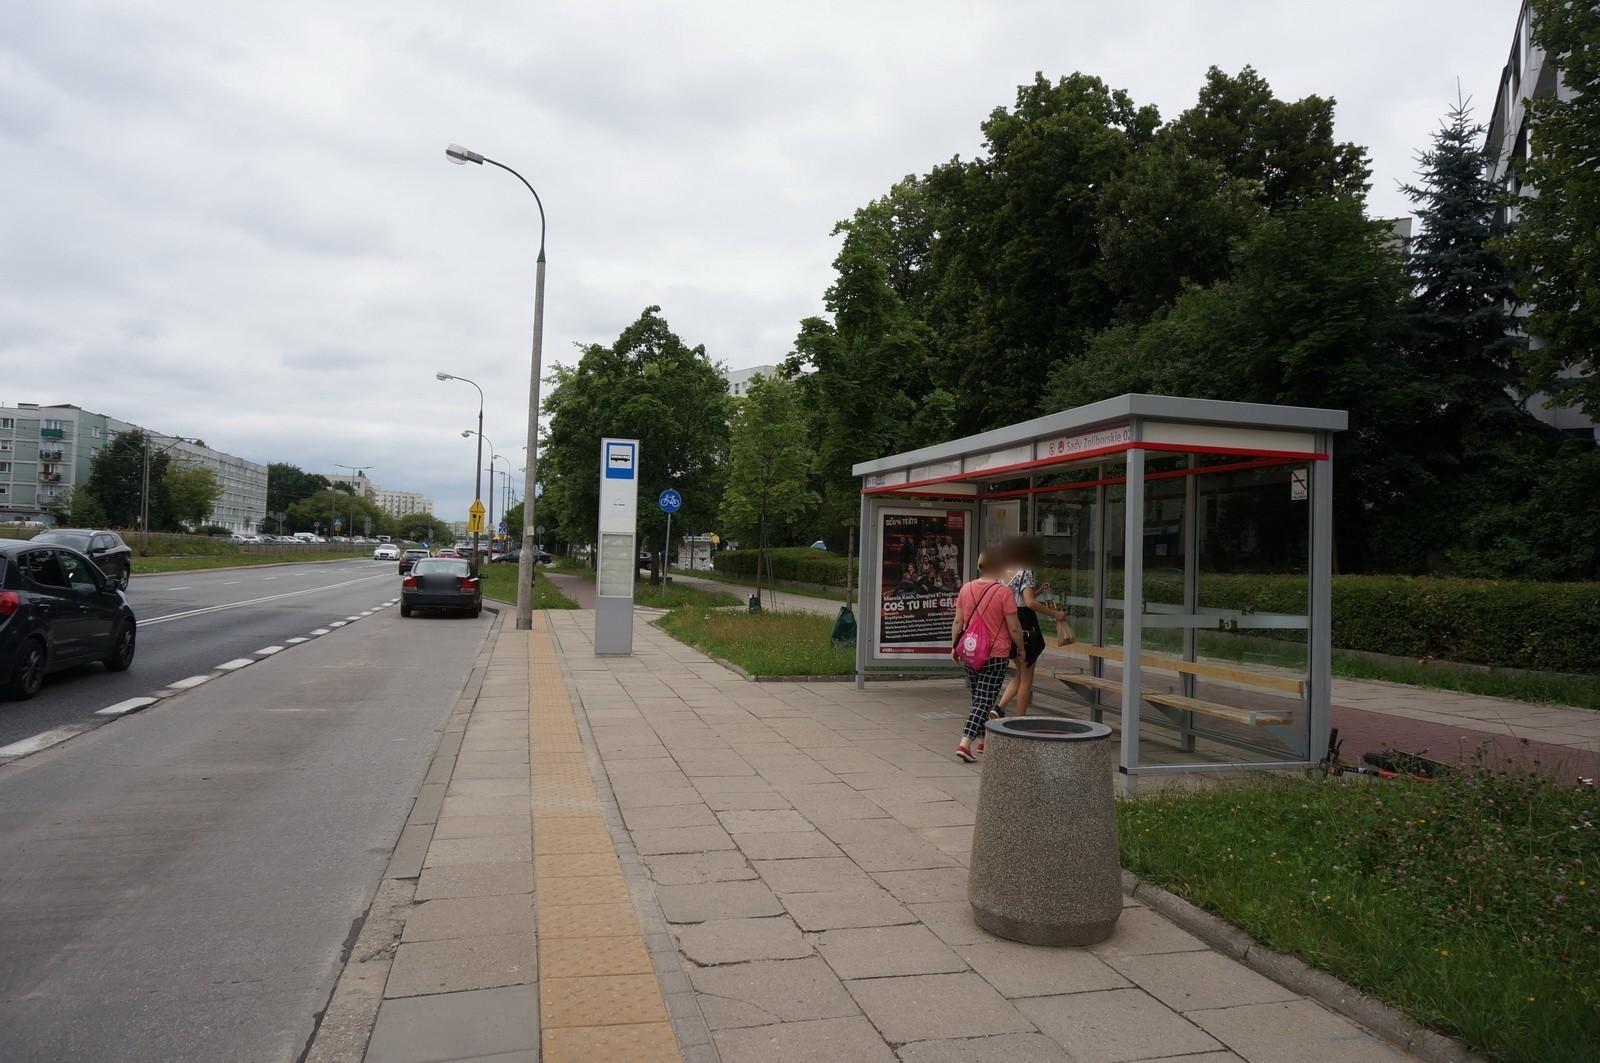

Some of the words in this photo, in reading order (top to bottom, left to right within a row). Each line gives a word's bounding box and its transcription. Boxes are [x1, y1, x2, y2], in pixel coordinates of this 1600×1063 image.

[883, 599, 905, 612] COŚ
[907, 600, 920, 611] TU
[922, 599, 938, 609] NIE
